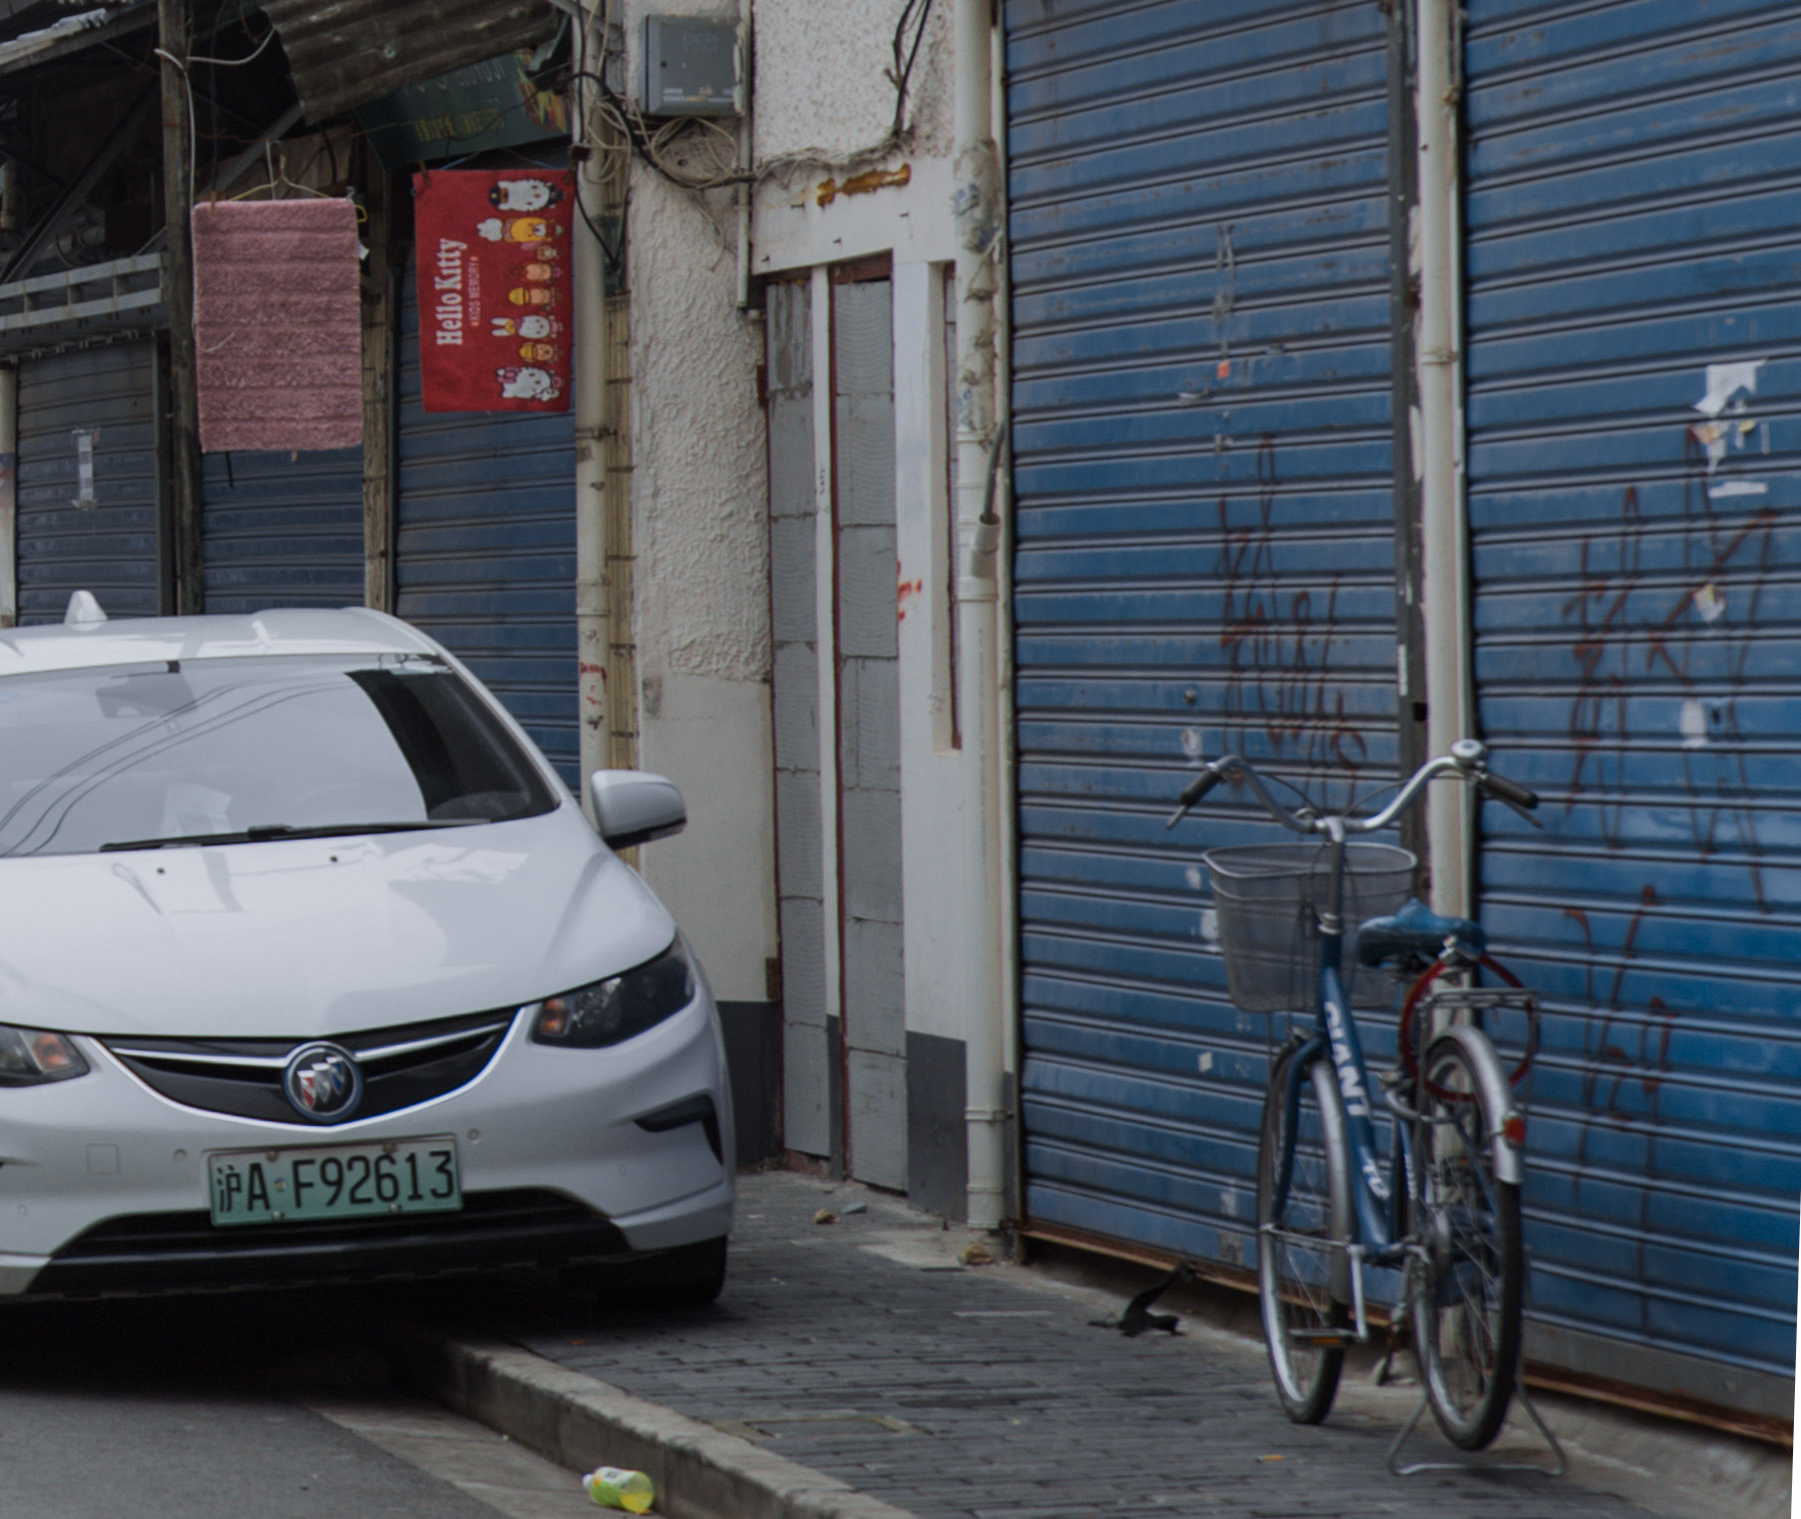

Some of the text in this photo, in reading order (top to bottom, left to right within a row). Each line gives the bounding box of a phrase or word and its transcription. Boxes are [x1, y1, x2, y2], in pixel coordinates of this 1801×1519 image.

[433, 238, 468, 346] Hello Kitty
[467, 262, 480, 321] KIDS MEMORY
[1324, 1000, 1372, 1125] GIANT
[215, 1149, 455, 1213] 沪A F92613
